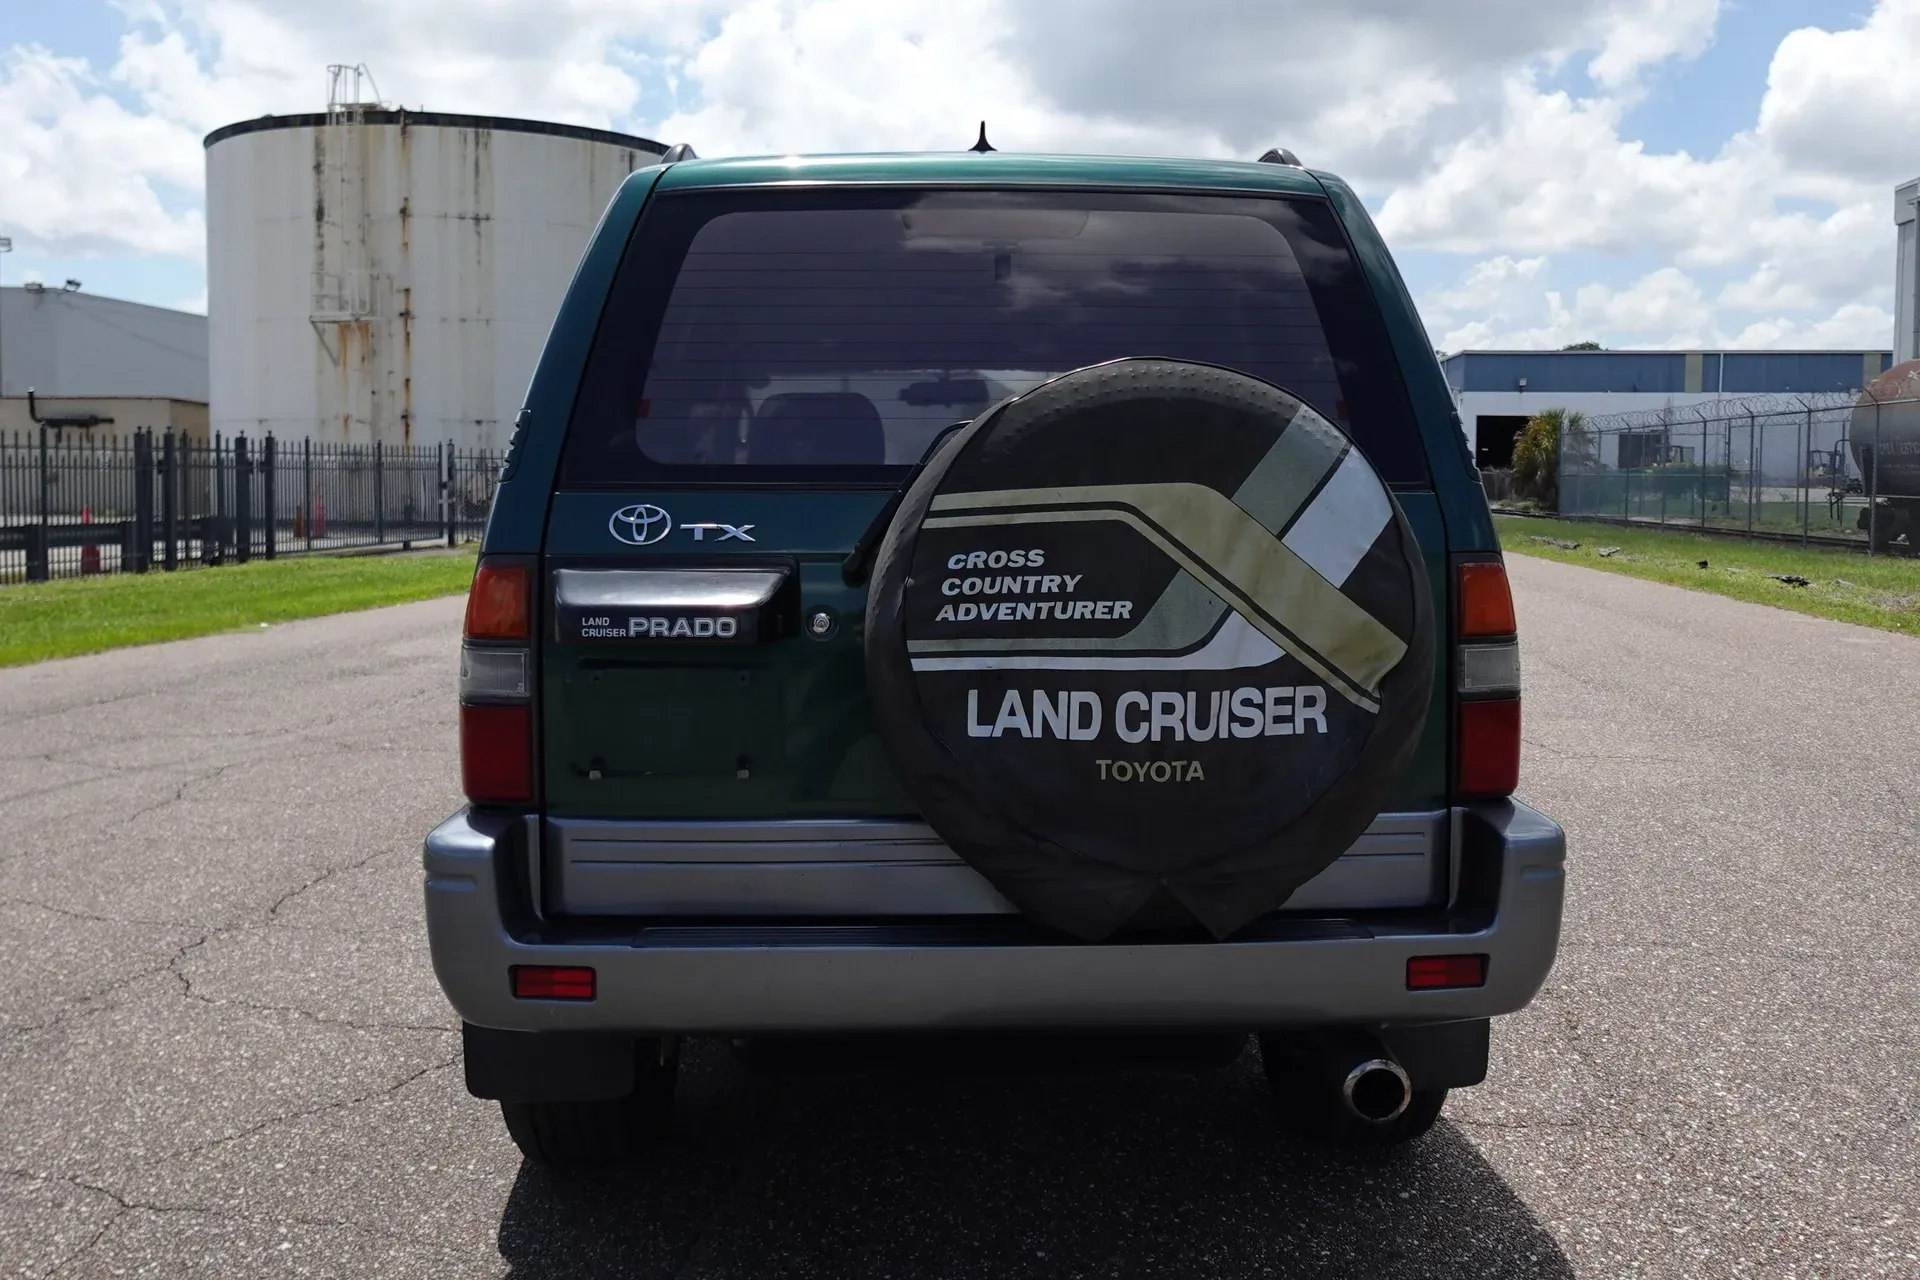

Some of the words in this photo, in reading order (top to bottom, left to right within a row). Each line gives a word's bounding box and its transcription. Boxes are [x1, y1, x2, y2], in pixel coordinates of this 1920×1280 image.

[680, 524, 756, 542] TX
[947, 549, 1045, 570] CROSS
[941, 574, 1083, 596] COUNTRY
[581, 617, 610, 626] LAND
[935, 600, 1133, 622] ADVENTURER
[581, 628, 627, 637] CRUISER
[628, 617, 737, 638] PRADO
[967, 689, 1102, 741] LAND
[1115, 685, 1328, 743] CRUISER
[1096, 759, 1205, 783] TOYOTA
